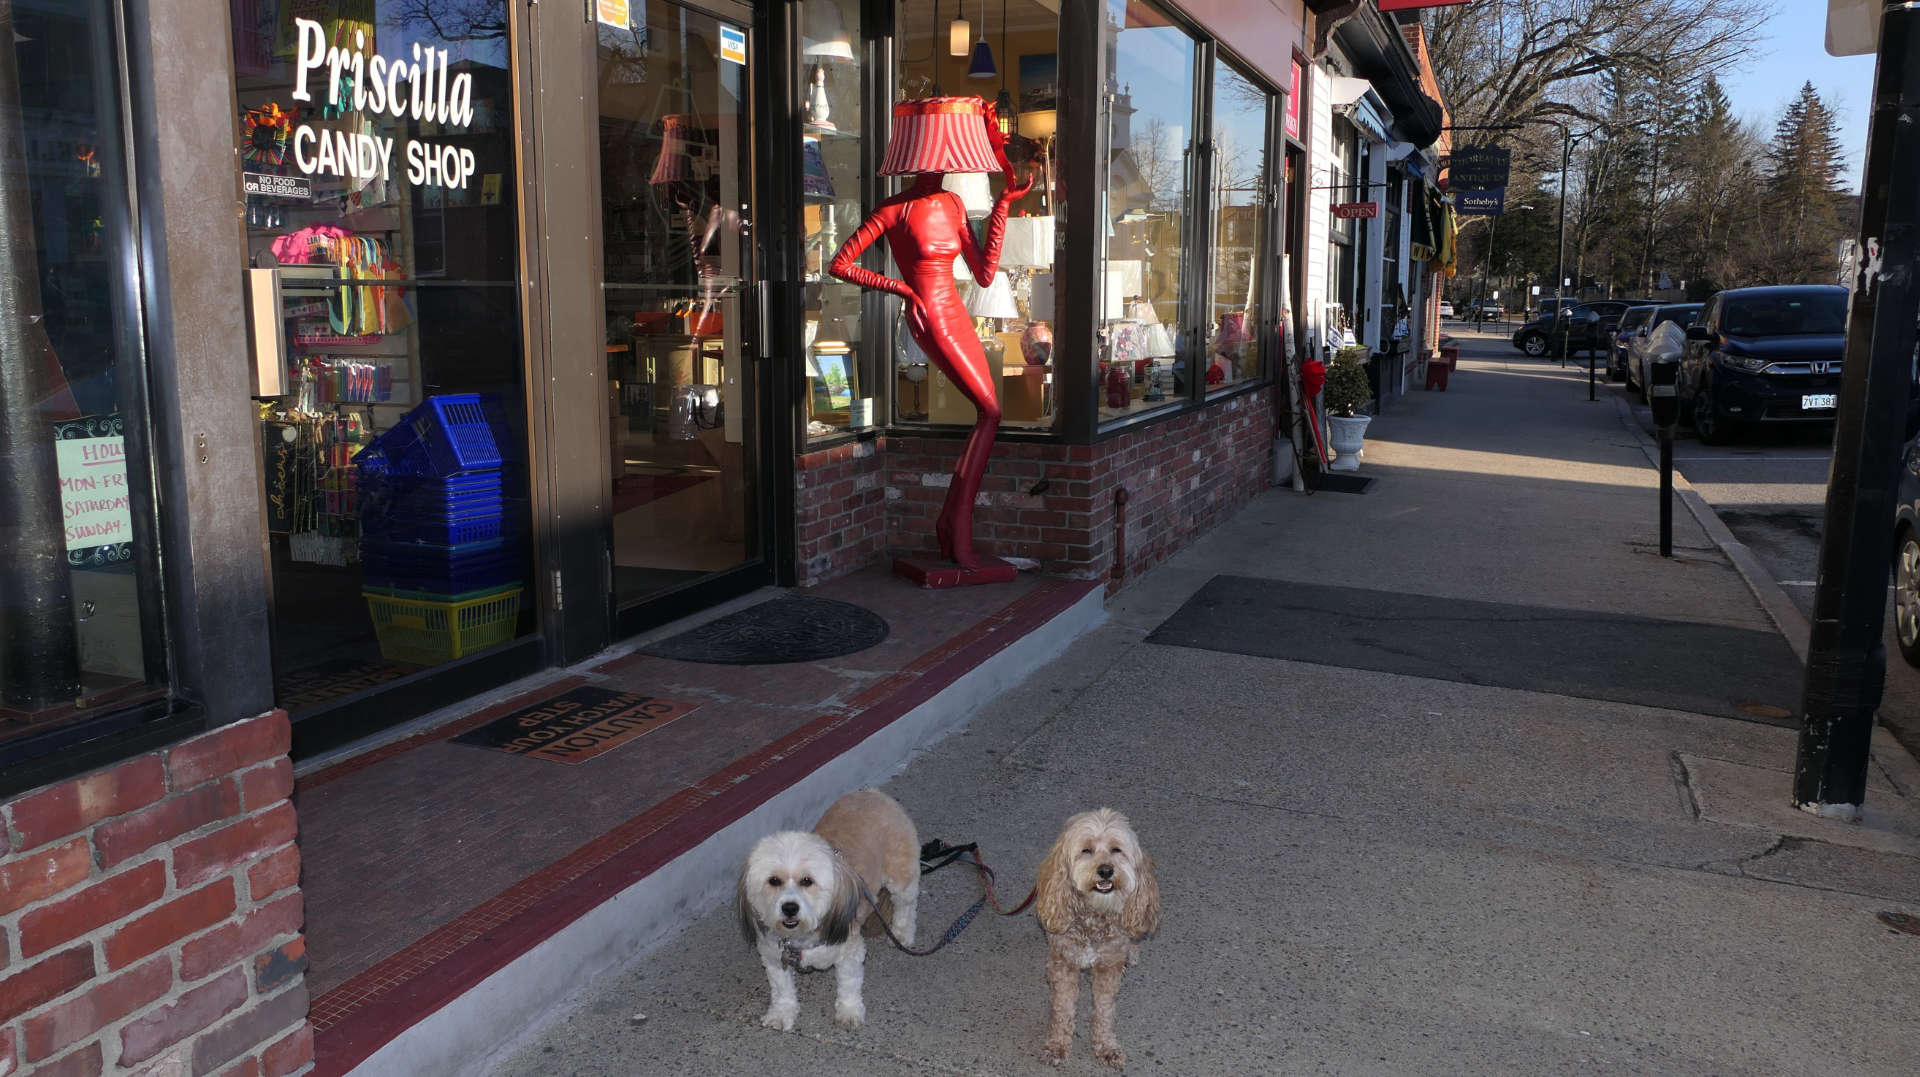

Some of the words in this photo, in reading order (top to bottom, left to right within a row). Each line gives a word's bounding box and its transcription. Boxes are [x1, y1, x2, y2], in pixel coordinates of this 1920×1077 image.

[292, 17, 474, 128] Priscilla
[294, 124, 394, 181] CANDY
[407, 139, 476, 190] SHOP
[246, 182, 259, 191] OR
[260, 184, 309, 196] BEVERAGES
[259, 176, 271, 185] NO
[273, 177, 296, 187] FOOD
[1341, 207, 1375, 217] OPEN
[1463, 197, 1498, 208] Sotheby's
[82, 443, 125, 461] HOU
[518, 701, 584, 727] STEP
[562, 692, 642, 727] WATCH
[502, 722, 568, 753] YOUR
[543, 703, 673, 757] CAUTION
